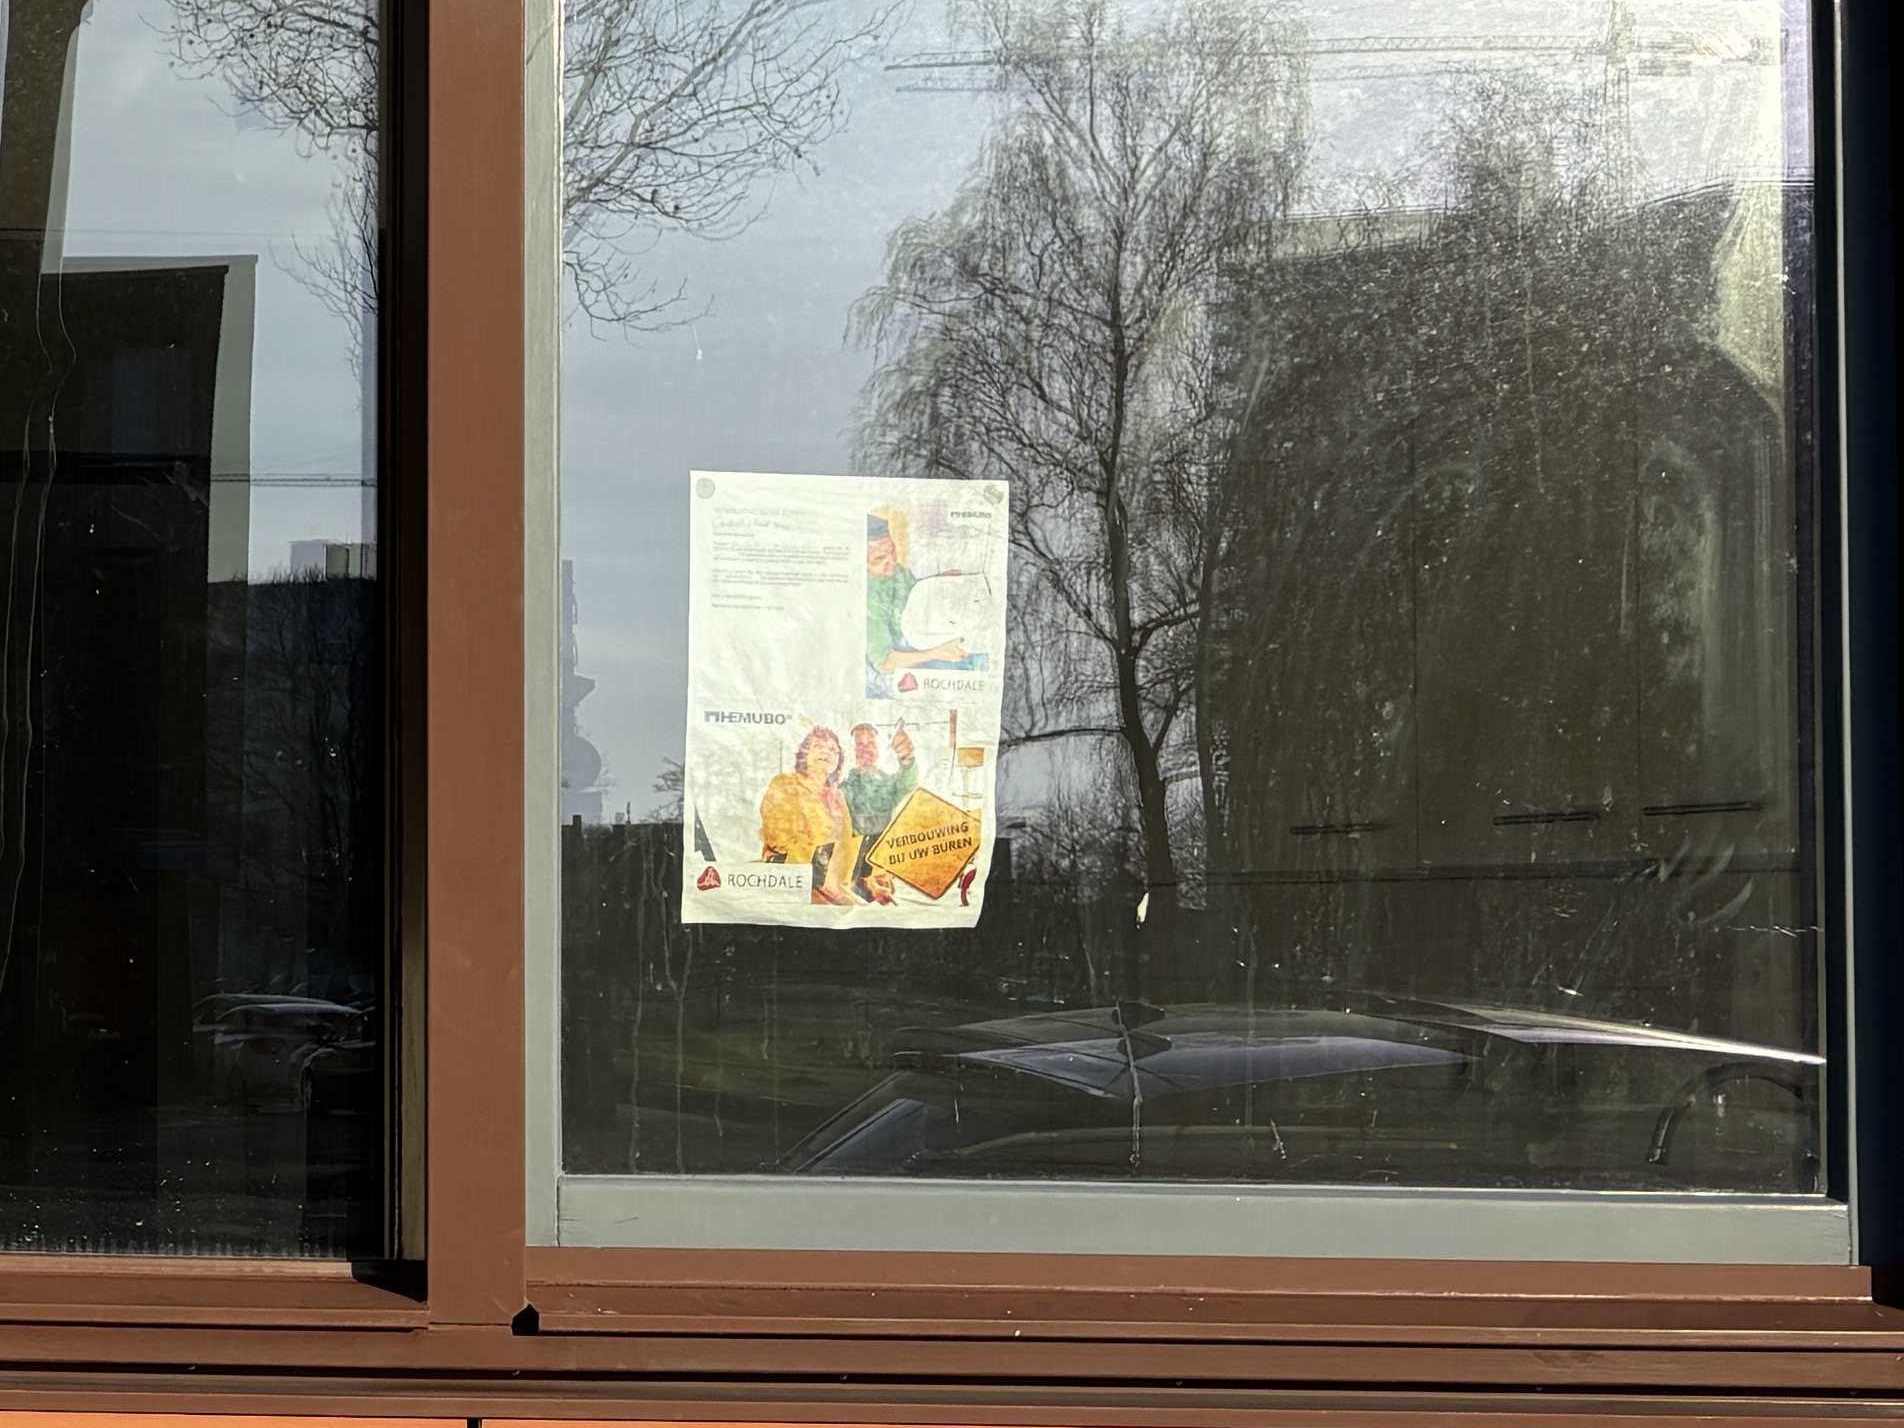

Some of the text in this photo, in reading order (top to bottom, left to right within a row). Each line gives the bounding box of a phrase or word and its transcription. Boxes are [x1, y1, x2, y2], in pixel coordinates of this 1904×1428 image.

[923, 677, 985, 691] ROCHDALE
[886, 821, 969, 848] VERBOUWING
[909, 846, 929, 860] UW
[932, 837, 973, 855] BUREN
[727, 874, 803, 889] ROCHDALE
